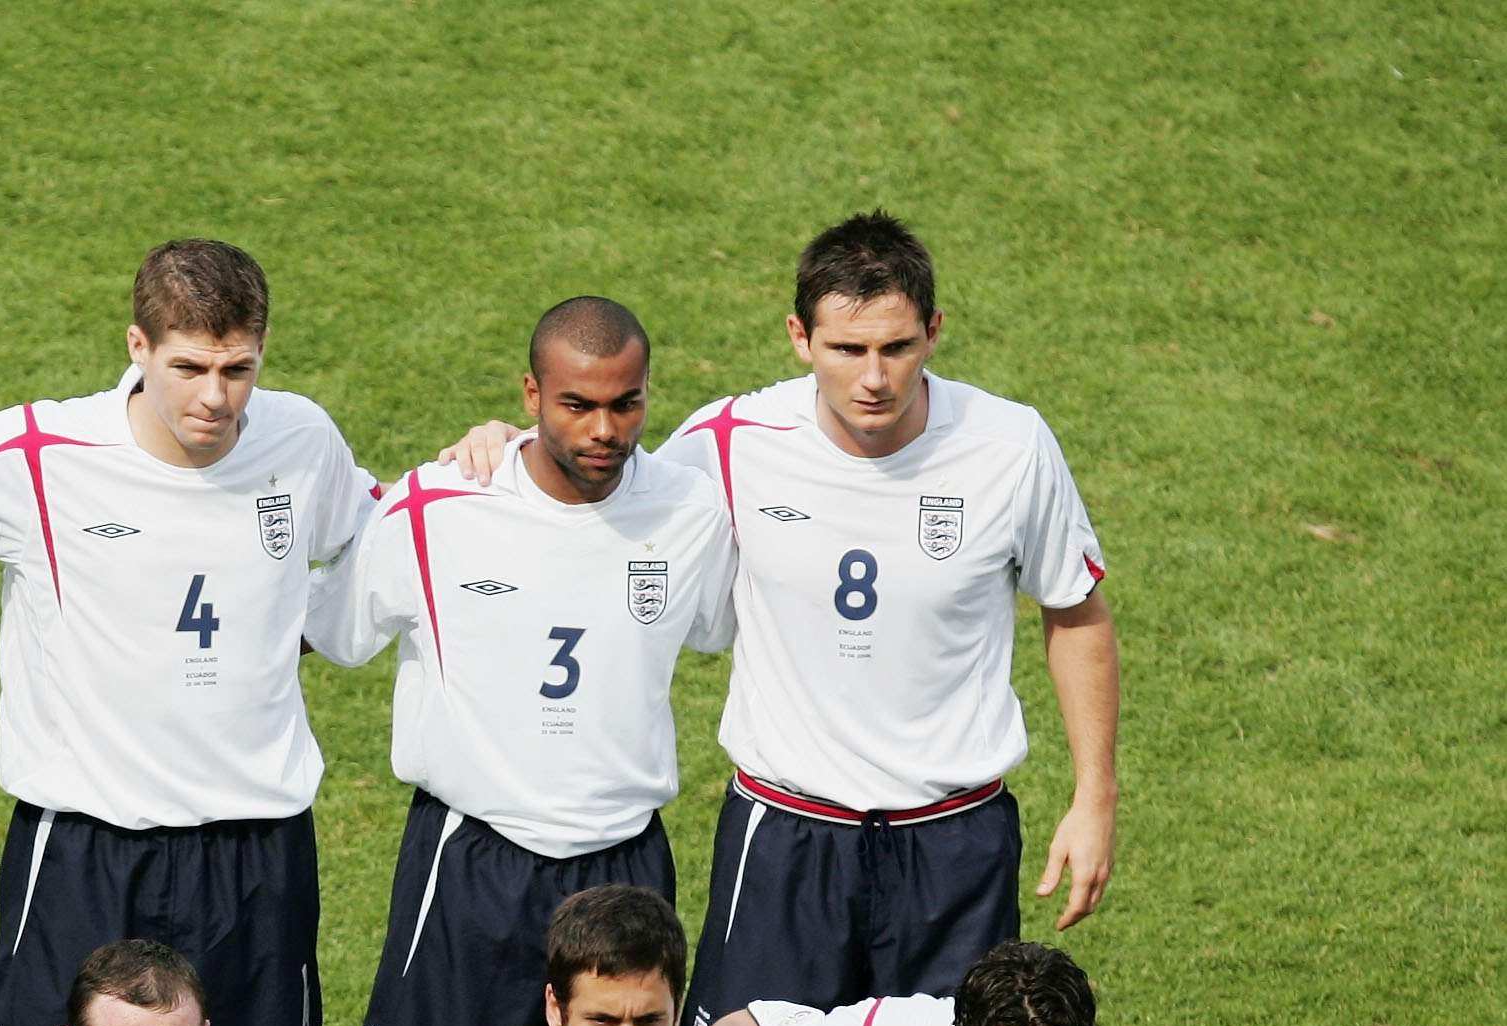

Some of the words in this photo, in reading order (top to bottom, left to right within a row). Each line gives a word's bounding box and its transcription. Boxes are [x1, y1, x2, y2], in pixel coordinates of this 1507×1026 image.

[175, 574, 220, 648] 4
[834, 549, 878, 620] 8
[539, 626, 586, 699] 3
